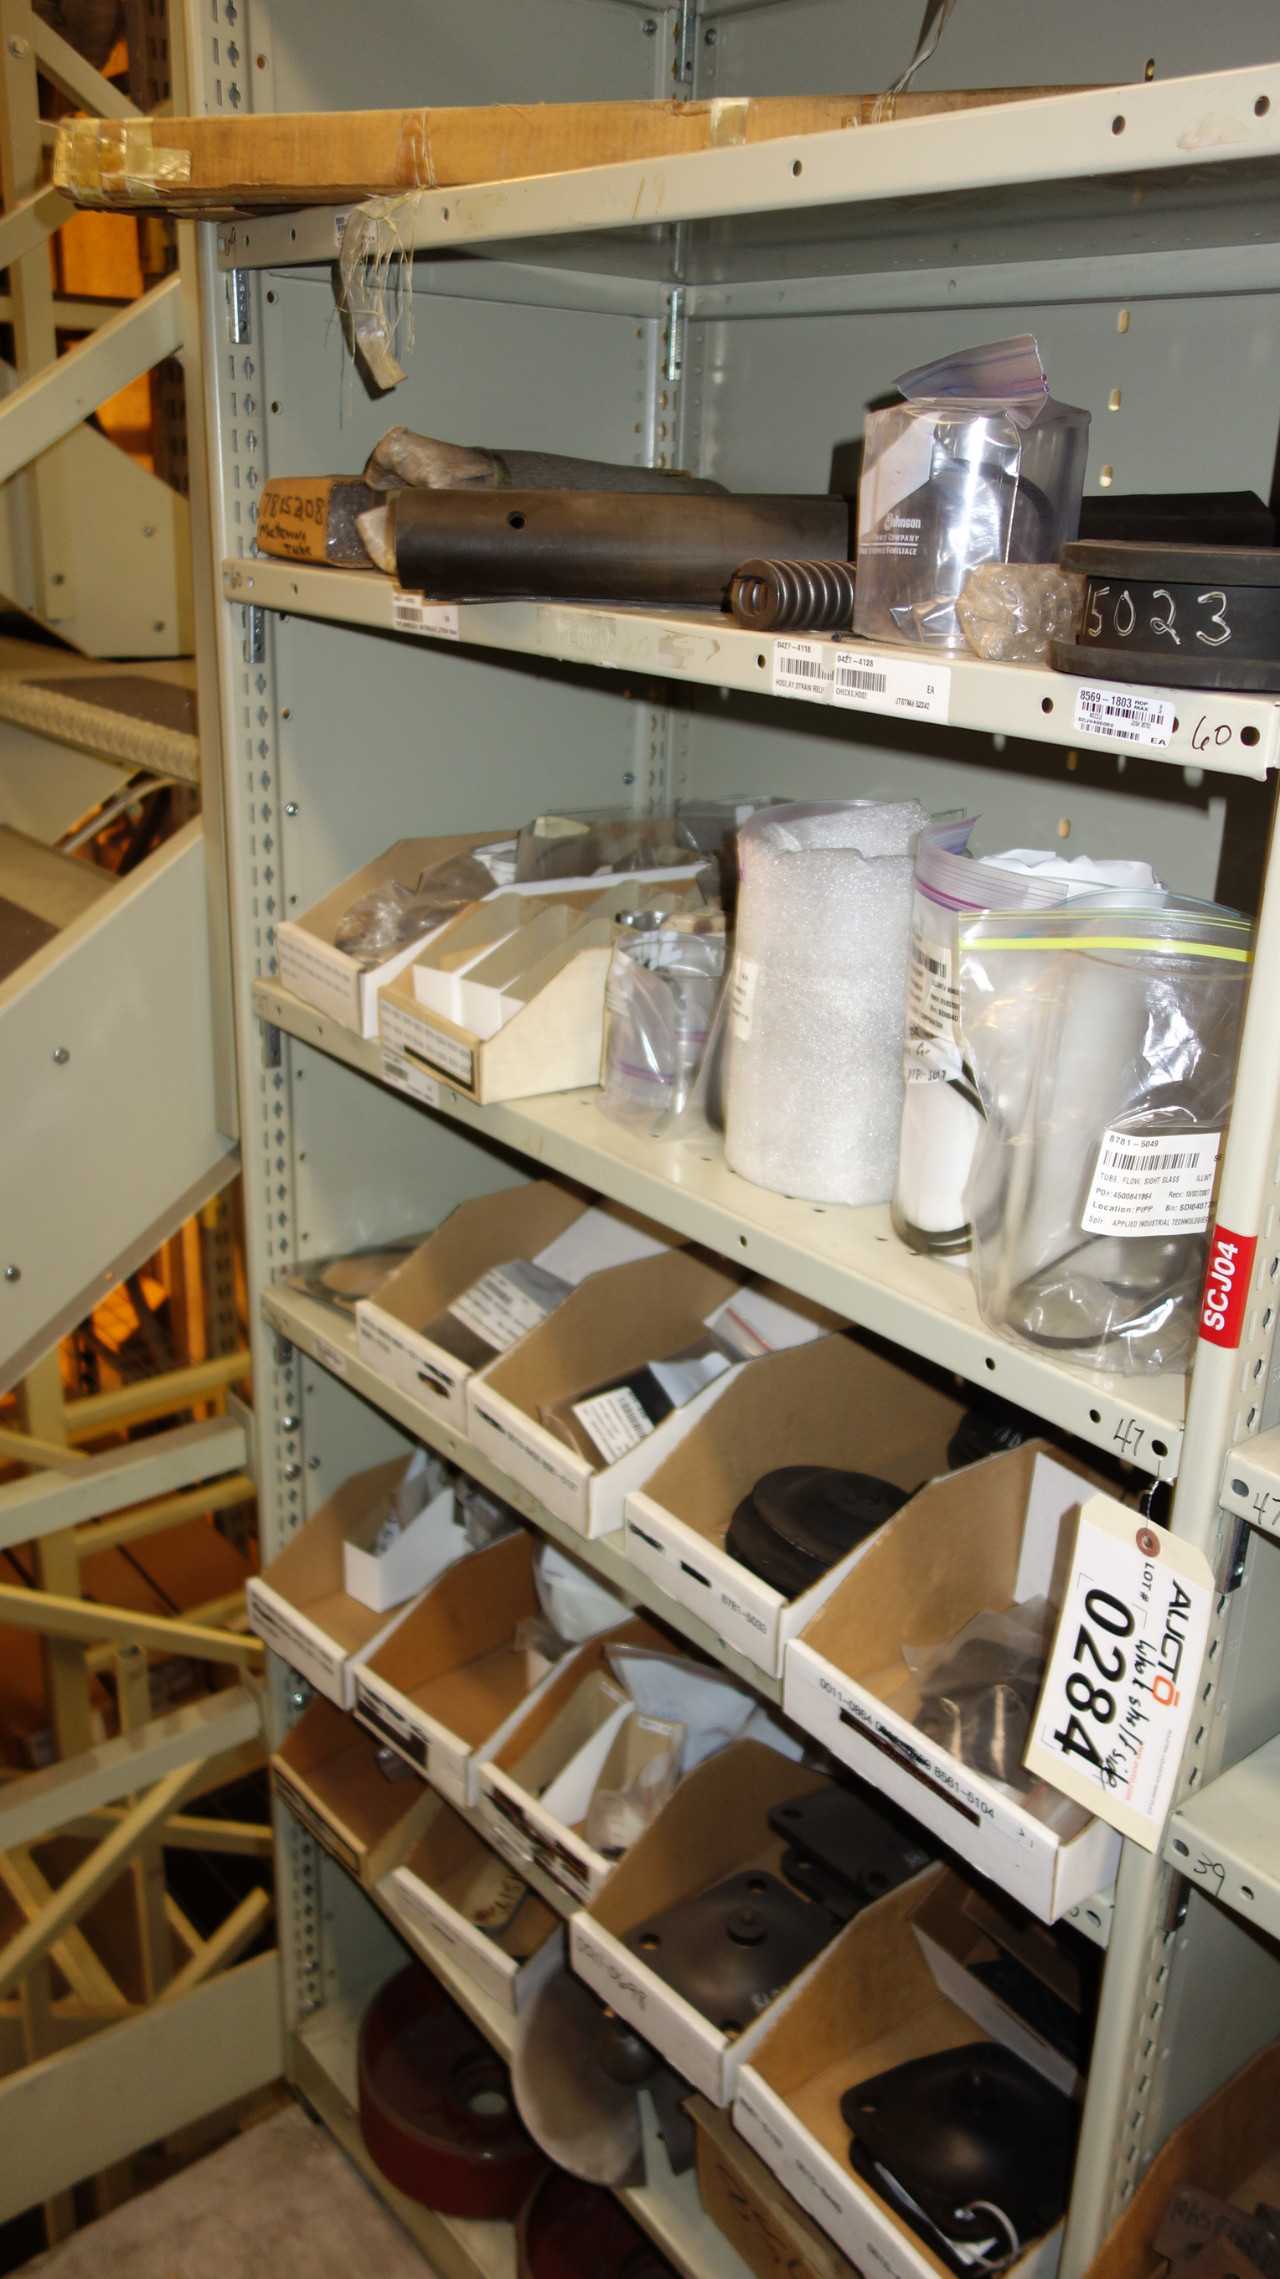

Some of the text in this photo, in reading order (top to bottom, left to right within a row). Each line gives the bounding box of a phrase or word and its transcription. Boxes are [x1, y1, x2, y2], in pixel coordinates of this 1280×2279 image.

[1150, 737, 1167, 746] EA
[1192, 715, 1232, 751] 60
[1203, 1241, 1239, 1331] SCJ04
[1113, 1418, 1145, 1456] 47
[1141, 1562, 1155, 1591] LOT
[1055, 1588, 1136, 1777] 0284
